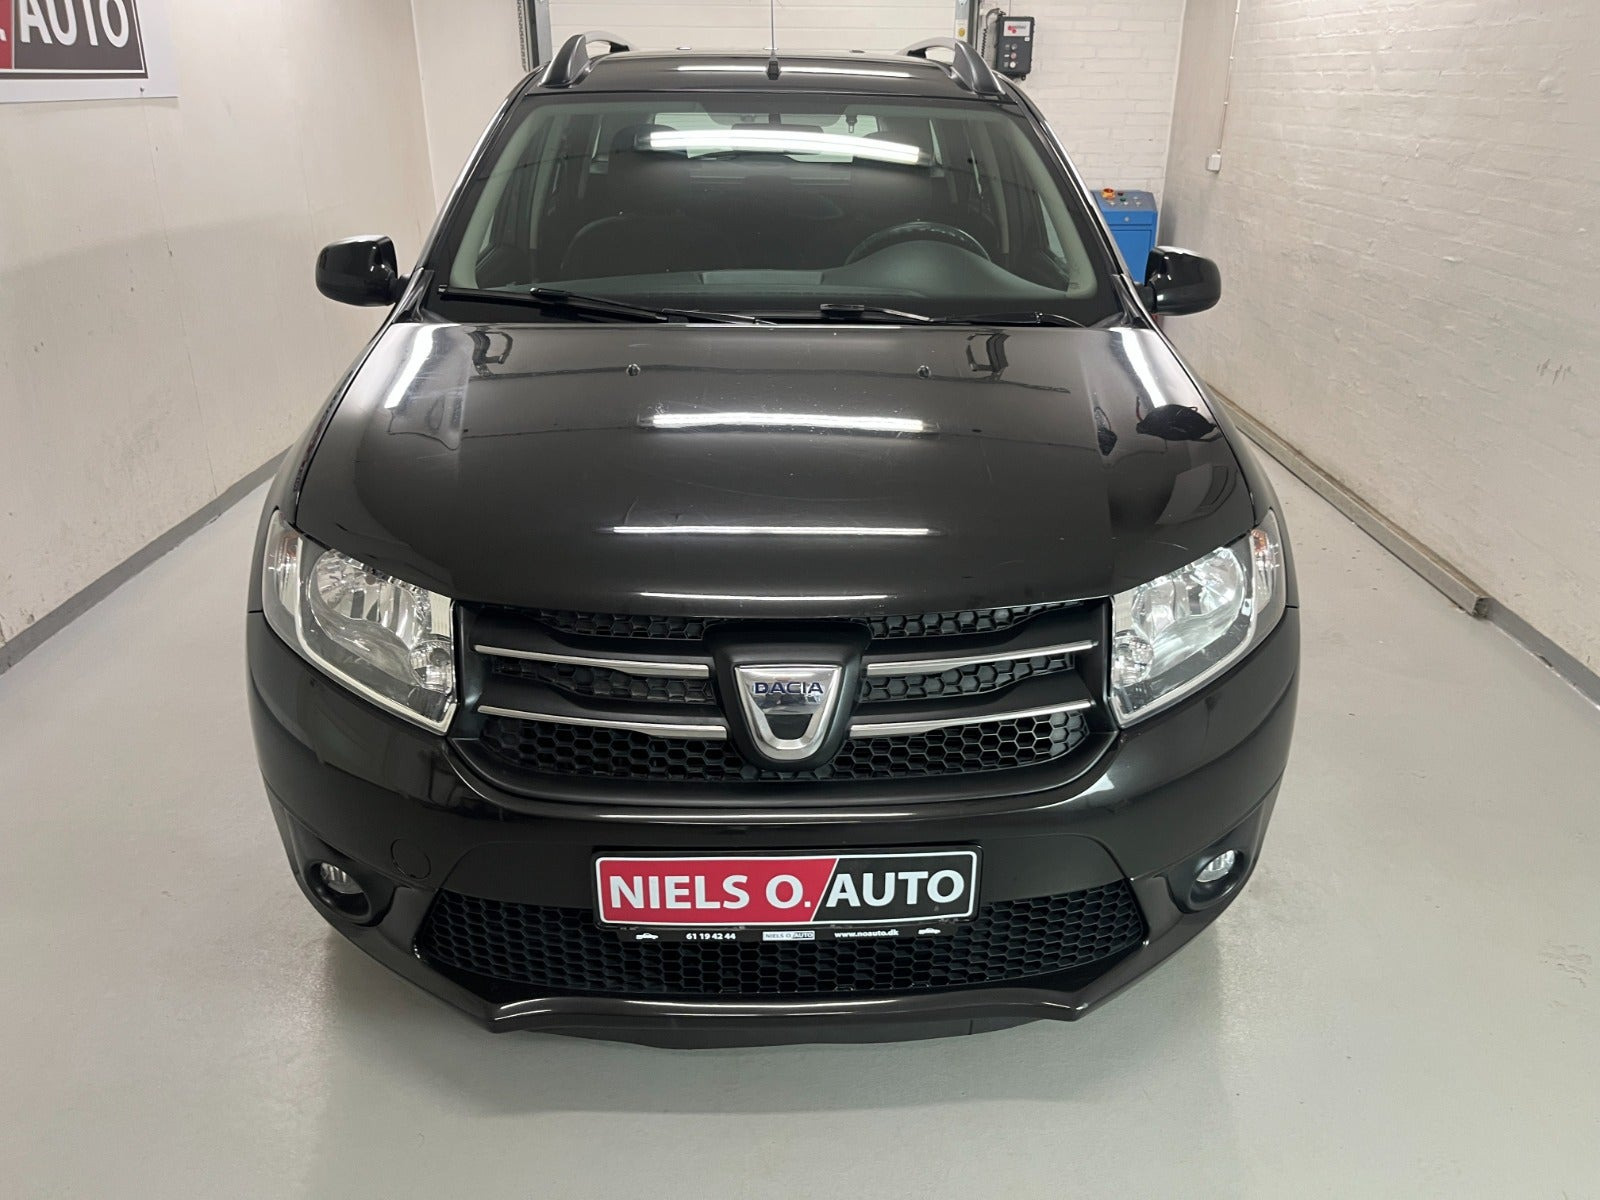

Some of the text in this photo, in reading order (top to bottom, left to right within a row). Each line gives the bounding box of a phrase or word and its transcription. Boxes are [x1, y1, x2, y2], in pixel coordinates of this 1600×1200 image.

[753, 681, 824, 694] DACIA
[609, 869, 965, 909] NIELS O. AUTO
[724, 932, 736, 940] 44
[834, 929, 899, 938] www.noauto.dk
